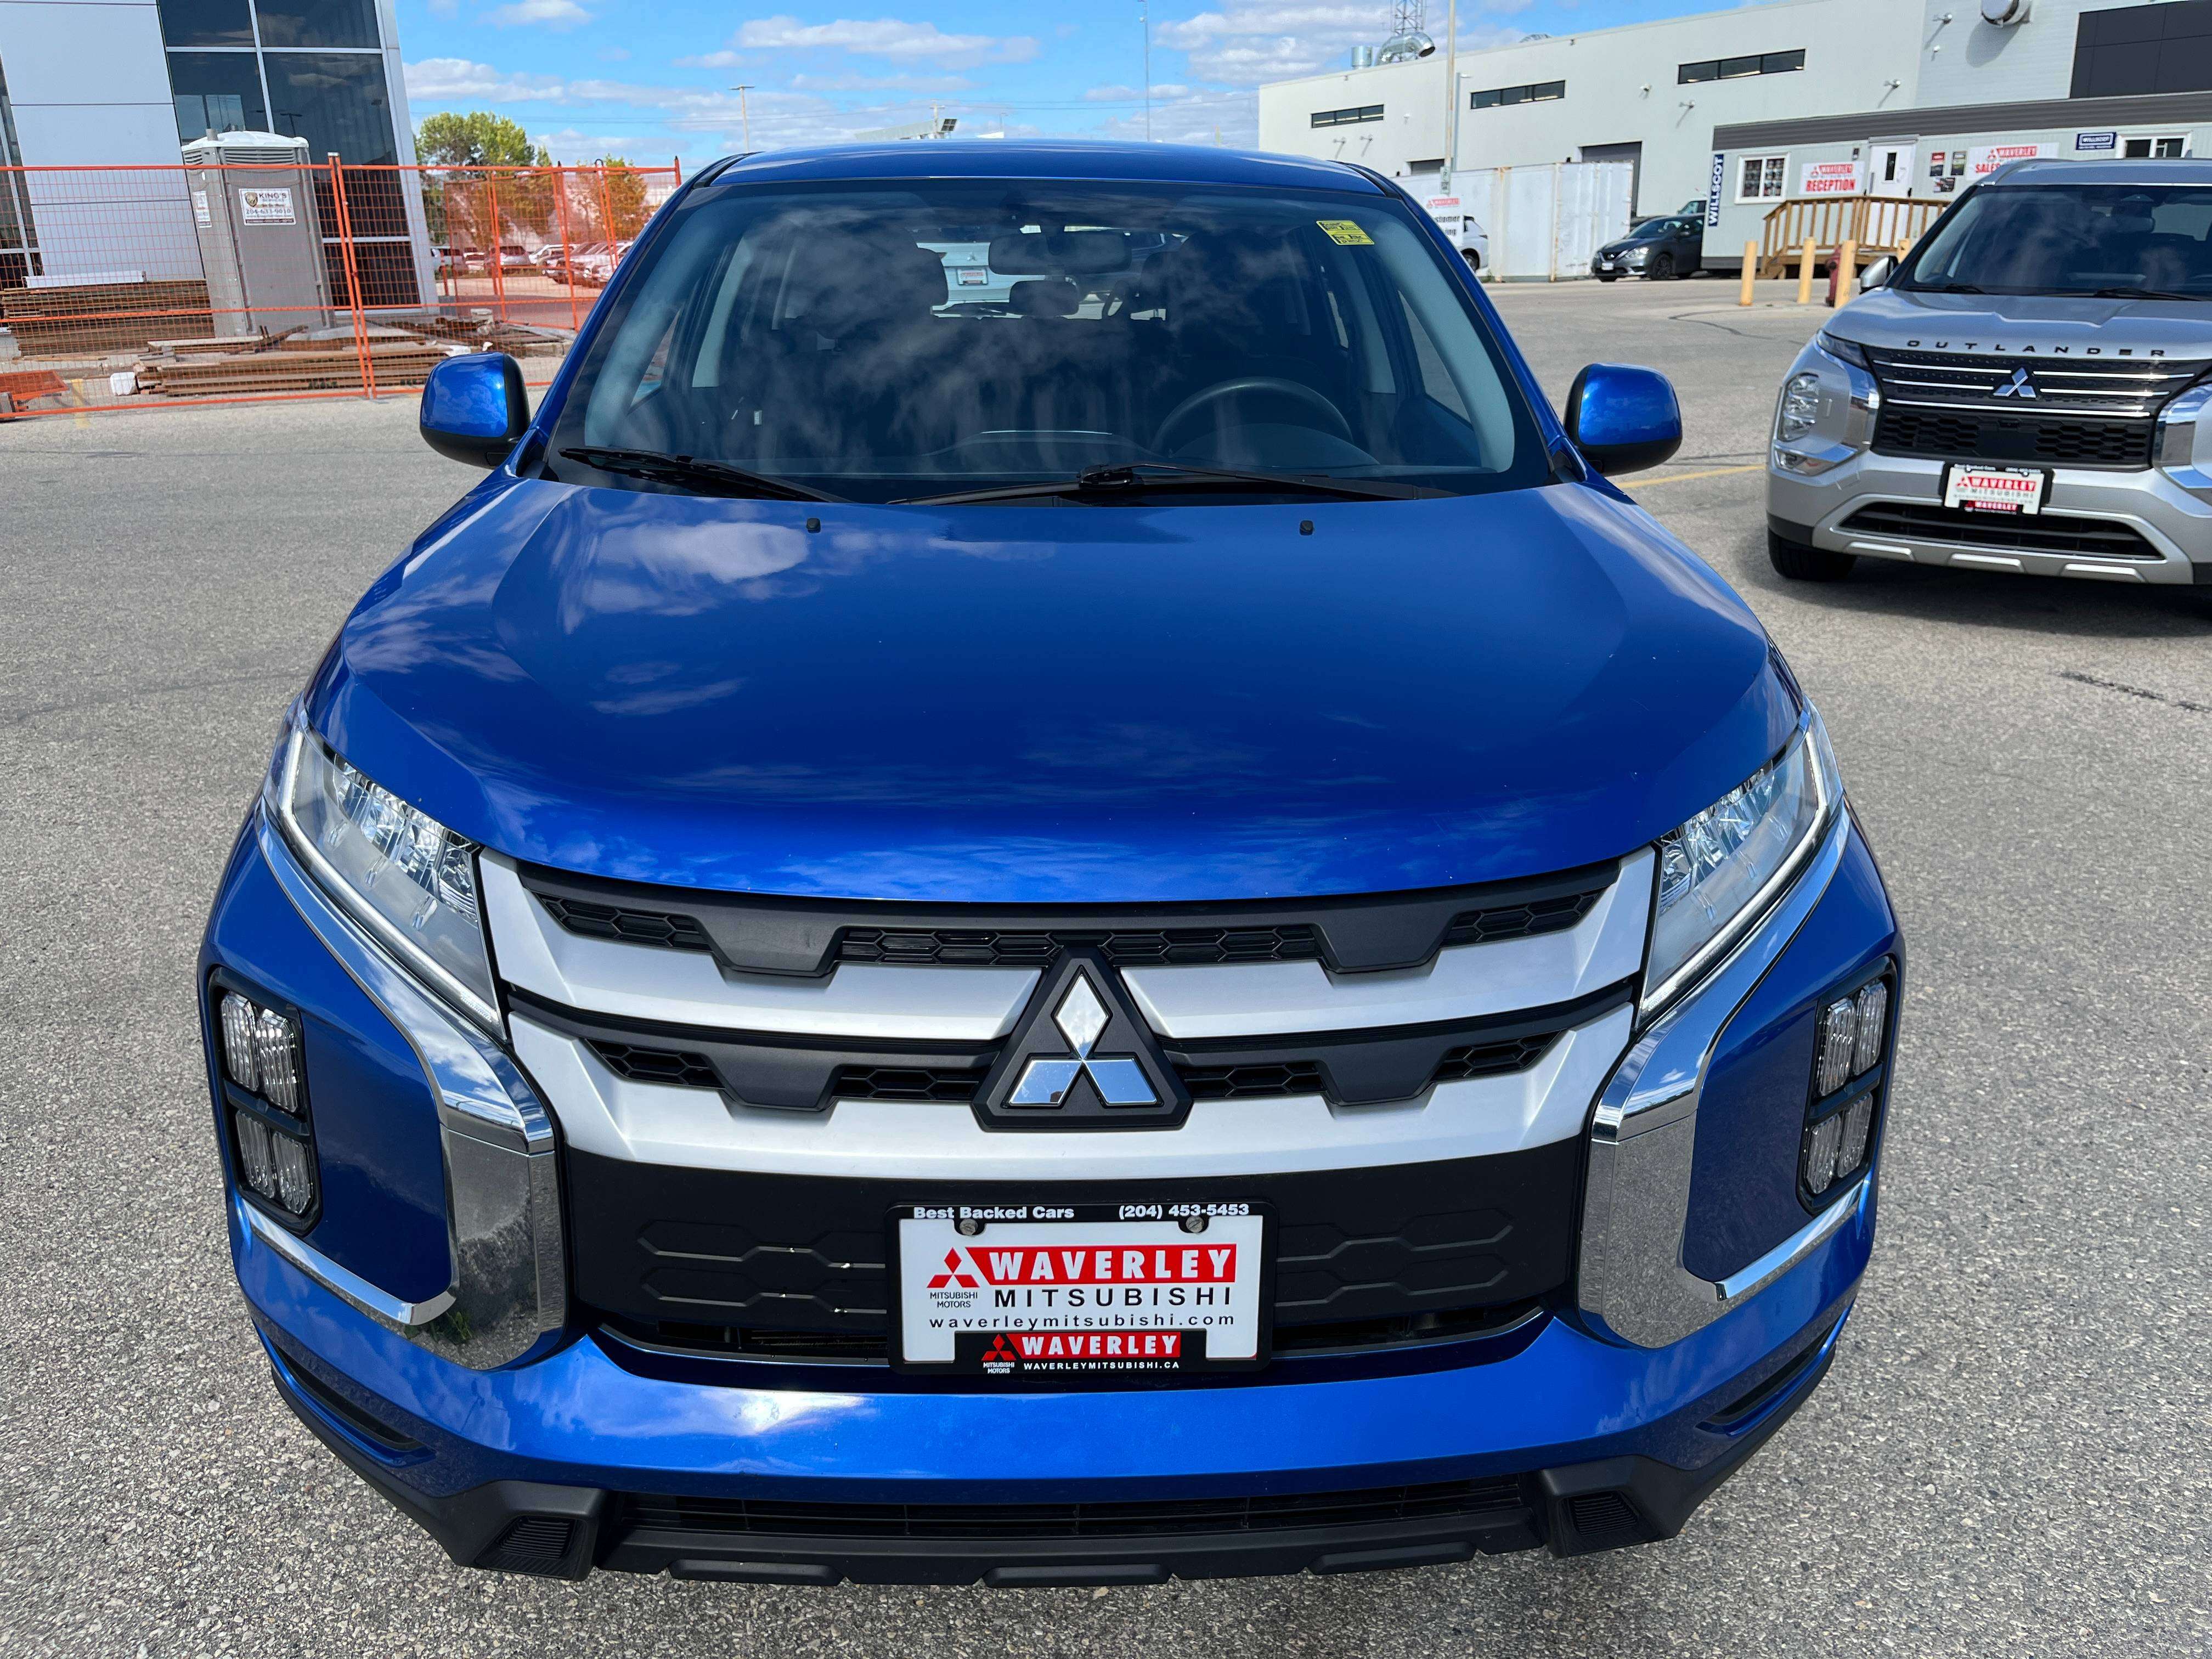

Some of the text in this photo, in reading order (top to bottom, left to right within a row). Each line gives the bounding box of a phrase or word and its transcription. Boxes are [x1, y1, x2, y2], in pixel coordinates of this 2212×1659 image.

[1708, 156, 1723, 224] WILLSCOT
[1806, 179, 1856, 191] RECEPTION
[1906, 340, 2165, 357] OUTLANDER
[1972, 477, 2035, 491] WAVERLEY
[913, 1204, 1250, 1220] Best Backed Cars (204) 453-5453
[989, 1249, 1231, 1280] WAVERLEY
[994, 1287, 1230, 1307] MITSUBISHI
[929, 1313, 1234, 1330] waverleymitsubishi.com
[1022, 1335, 1177, 1356] WAVERLEY
[1024, 1362, 1179, 1370] WAVERLEYMITSUBISHI.CA
